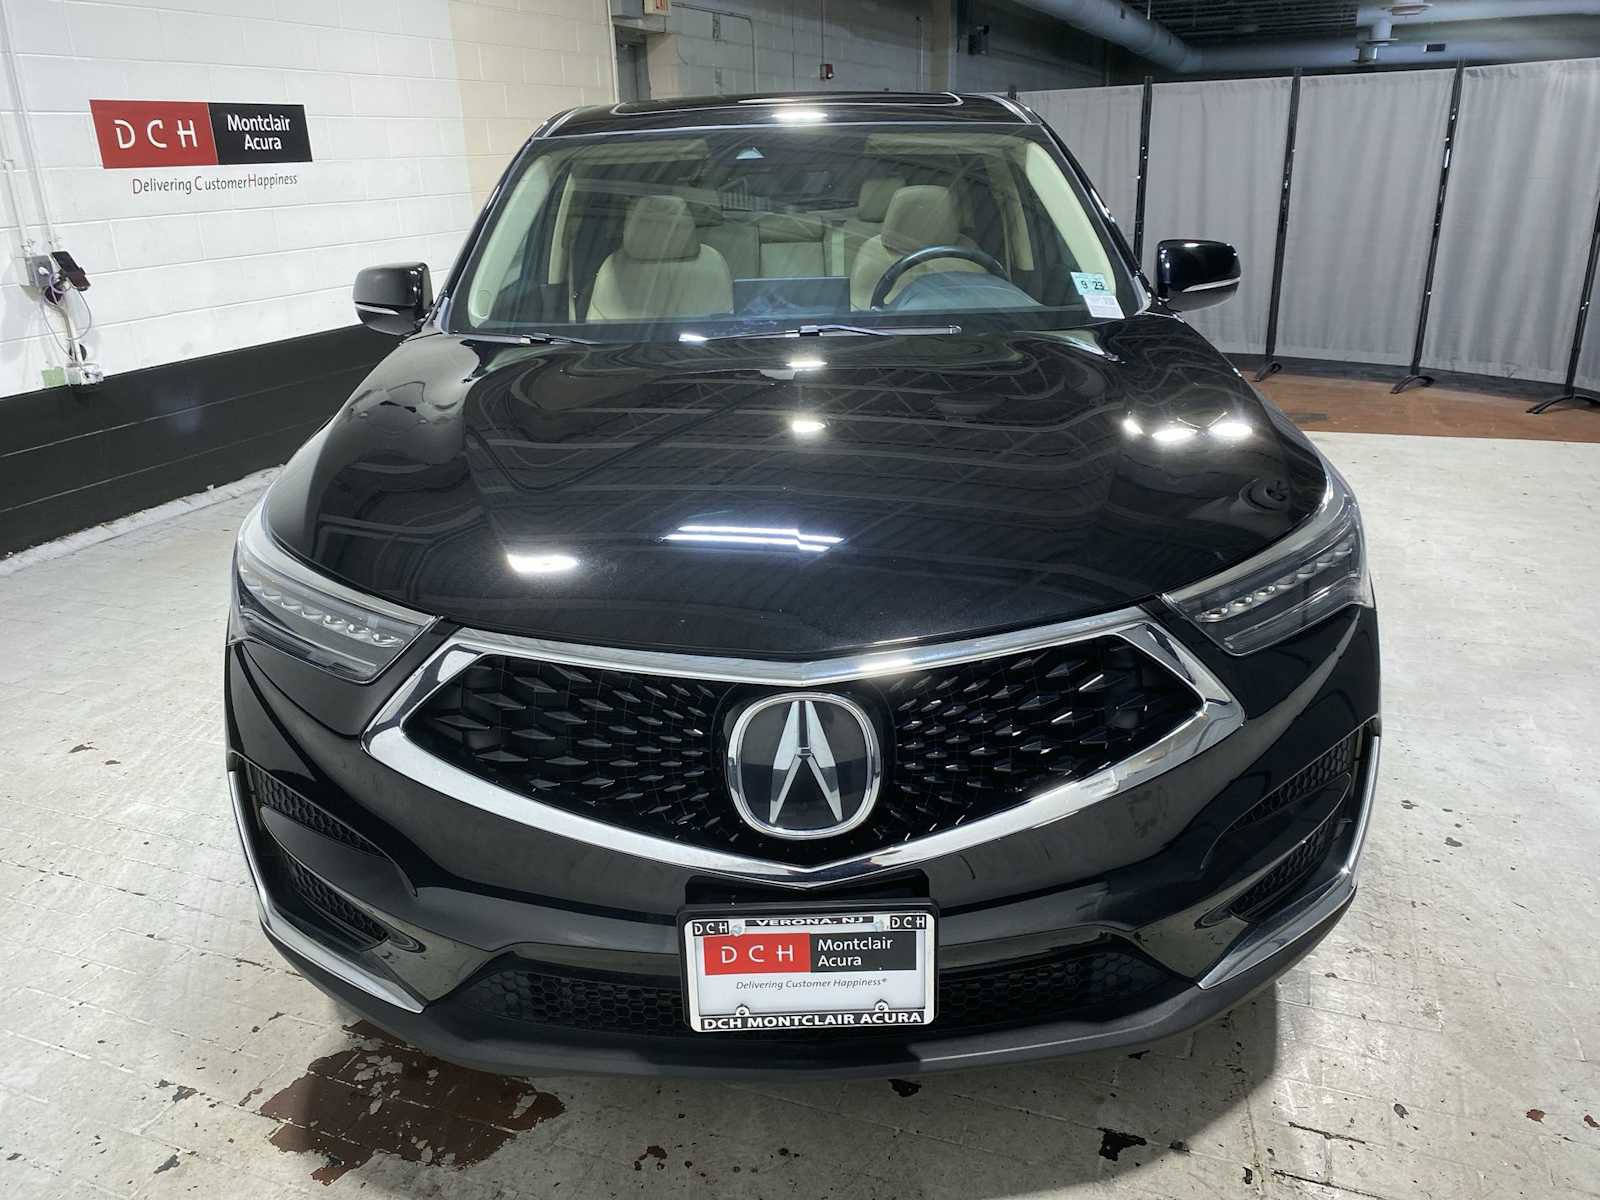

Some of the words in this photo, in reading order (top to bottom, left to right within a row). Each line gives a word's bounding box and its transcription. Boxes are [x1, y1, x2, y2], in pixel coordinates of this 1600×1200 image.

[227, 114, 290, 132] Montclair
[113, 119, 198, 149] DCH
[244, 134, 282, 151] Acura
[132, 177, 192, 195] Delivering
[694, 922, 729, 934] DCH
[841, 916, 864, 924] NJ
[891, 916, 926, 928] DCH
[817, 936, 893, 951] Montclair
[720, 945, 794, 964] DCH
[817, 953, 862, 967] Acura
[736, 980, 783, 991] Delivering
[785, 978, 831, 989] Customer
[703, 1017, 742, 1030] DCH
[748, 1013, 855, 1029] MONTCLAIR
[860, 1011, 922, 1025] ACURA
